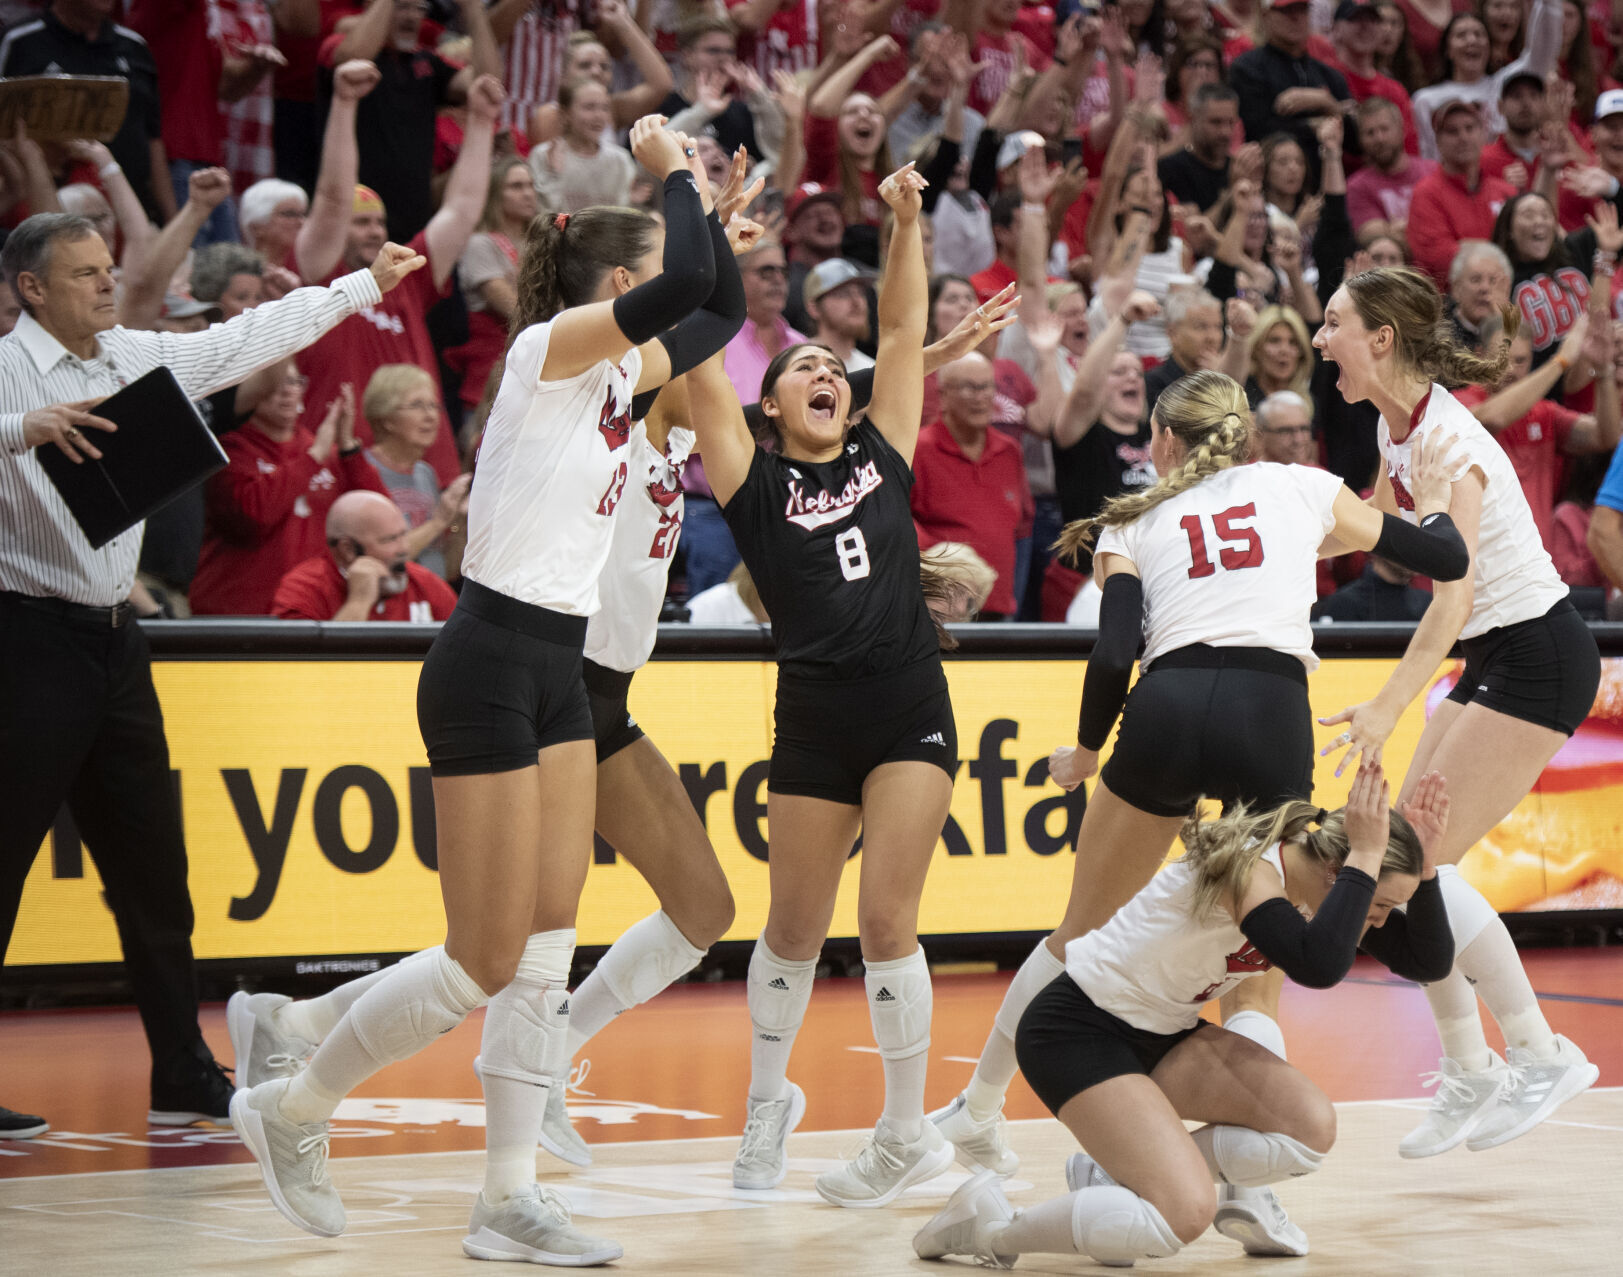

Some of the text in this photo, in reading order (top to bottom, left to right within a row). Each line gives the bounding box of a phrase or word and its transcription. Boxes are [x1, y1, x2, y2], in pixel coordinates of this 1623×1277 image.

[595, 461, 628, 516] 13
[785, 460, 883, 516] Nebraska
[835, 526, 870, 581] 8
[1180, 502, 1264, 579] 15
